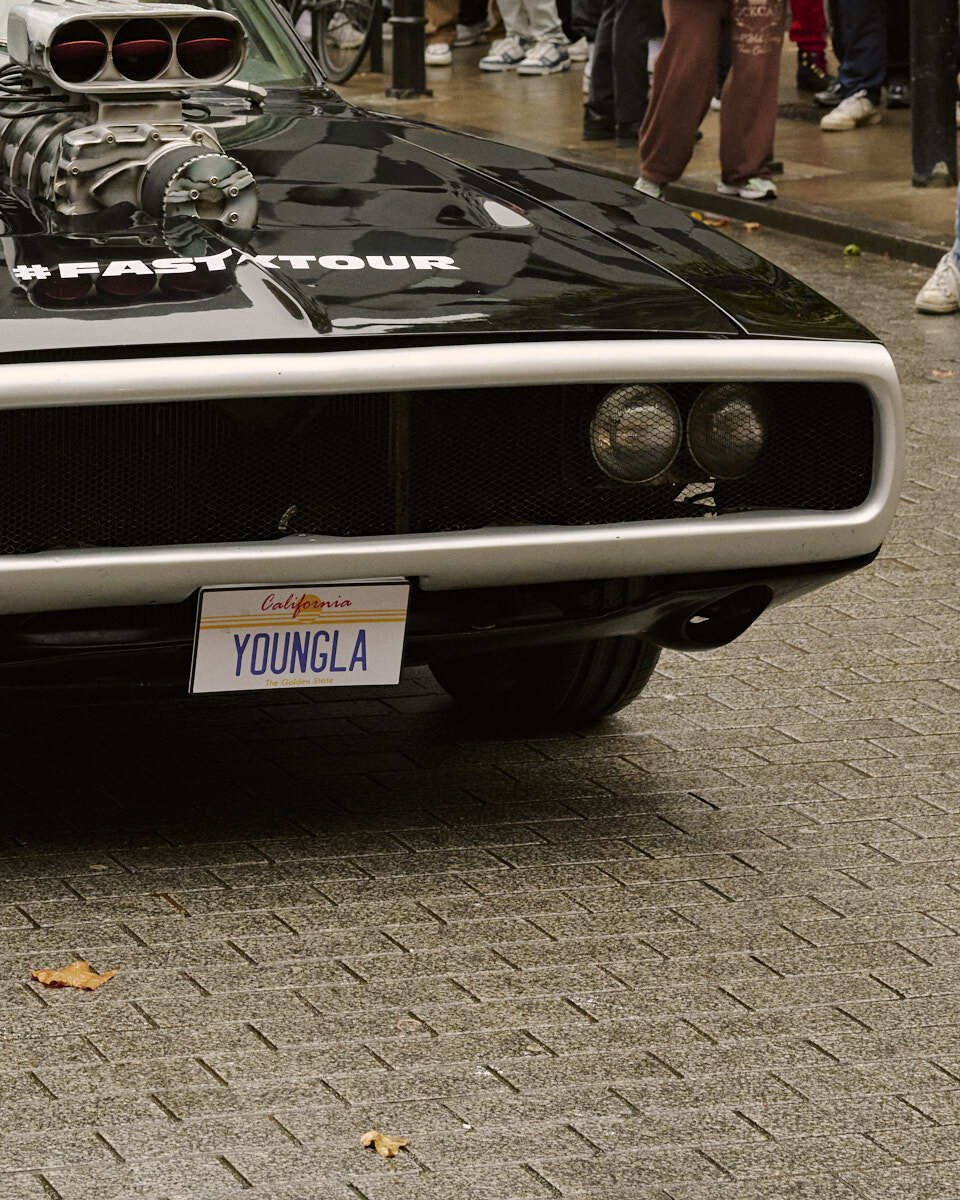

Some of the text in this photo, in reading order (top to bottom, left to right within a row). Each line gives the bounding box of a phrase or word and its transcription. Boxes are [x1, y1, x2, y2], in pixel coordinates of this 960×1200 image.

[260, 593, 352, 619] California
[233, 629, 367, 677] YOUNGLA
[265, 679, 279, 687] The
